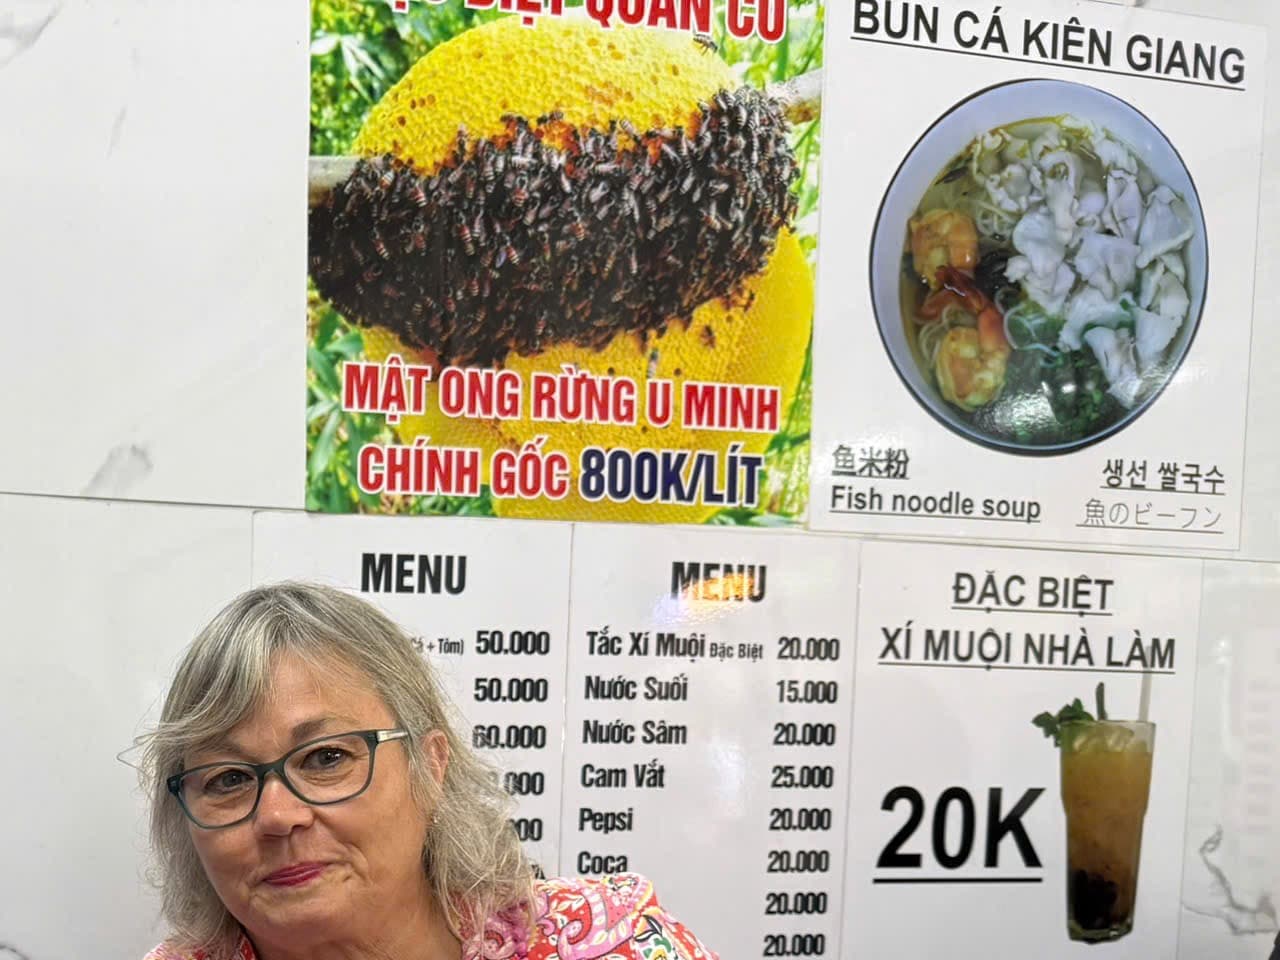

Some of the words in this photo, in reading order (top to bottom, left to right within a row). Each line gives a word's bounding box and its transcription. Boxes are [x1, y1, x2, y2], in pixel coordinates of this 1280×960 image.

[953, 6, 1009, 54] CÁ
[1022, 16, 1113, 67] KIÊN
[1125, 34, 1246, 85] GIANG
[344, 356, 430, 422] MẬT
[441, 369, 519, 418] ONG
[533, 366, 634, 423] RỪNG
[647, 379, 671, 425] U
[684, 385, 779, 431] MINH
[359, 438, 479, 494] CHÍNH
[493, 437, 569, 498] GỐC
[580, 445, 763, 504] 800K/LÍT
[1102, 458, 1148, 489] 생선
[1157, 462, 1225, 494] 쌀국수
[831, 485, 883, 511] Fish
[891, 492, 974, 516] noodle
[982, 499, 1041, 523] soup
[1083, 497, 1222, 529] 魚のビーフン
[361, 552, 468, 595] MENU
[670, 561, 768, 604] MENU
[952, 571, 1026, 613] ĐẶC
[1037, 574, 1114, 617] BIỆT
[438, 637, 464, 656] Tôm)
[475, 630, 550, 655] 50.000
[586, 625, 622, 656] Tắc
[628, 631, 649, 656] Xí
[655, 632, 705, 663] Muội
[709, 643, 734, 662] Đặc
[738, 643, 764, 662] Biệt
[776, 636, 840, 661] 20.000
[879, 620, 914, 660] XÍ
[923, 627, 1011, 671] MUỘI
[1023, 627, 1095, 667] NHÀ
[1105, 629, 1175, 669] LÀM
[473, 677, 548, 702] 50.000
[584, 674, 637, 700] Nước
[643, 673, 689, 701] Suối
[776, 680, 838, 704] 15.000
[472, 724, 546, 749] 60.000
[582, 719, 635, 744] Nước
[641, 720, 688, 745] Sâm
[773, 722, 836, 746] 20.000
[580, 763, 627, 789] Cam
[633, 758, 665, 789] Vắt
[770, 765, 833, 789] 25.000
[578, 807, 634, 834] Pepsi
[768, 808, 832, 831] 20.000
[875, 785, 1046, 870] 20K
[577, 850, 628, 874] Coca
[766, 850, 830, 873] 20.000
[764, 892, 827, 915] 20.000
[762, 933, 825, 957] 20.000
